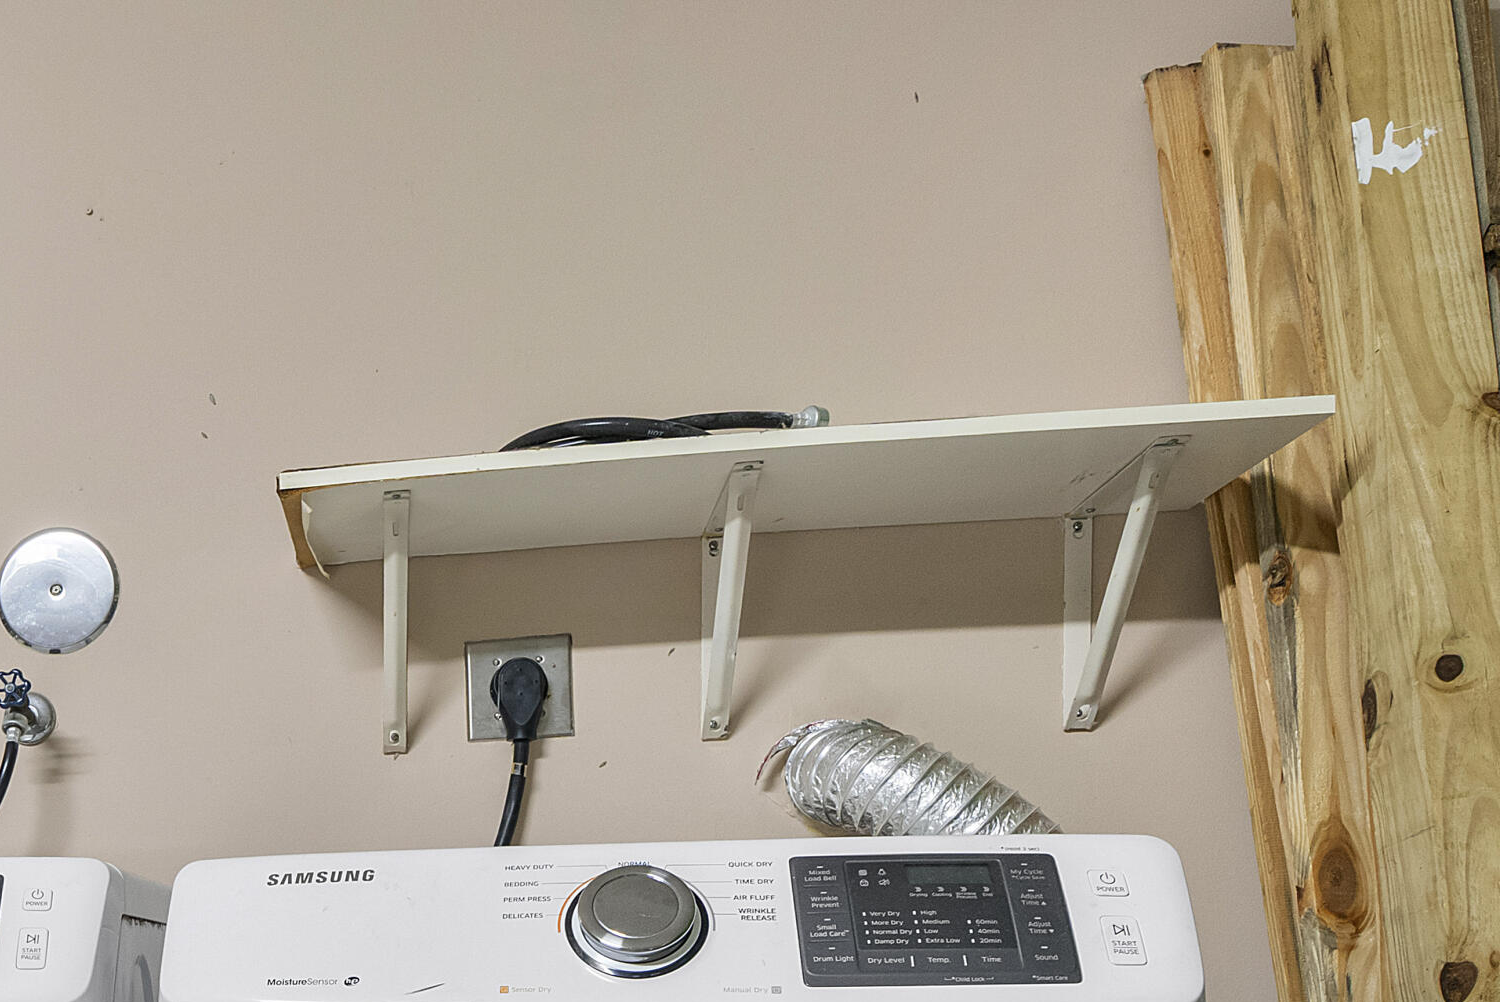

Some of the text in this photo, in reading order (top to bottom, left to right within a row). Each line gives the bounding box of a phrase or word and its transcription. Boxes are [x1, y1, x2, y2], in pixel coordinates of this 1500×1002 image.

[267, 869, 375, 886] SAMSUNG
[502, 912, 544, 920] DELICATES
[267, 977, 338, 986] MoistureSensor
[538, 986, 551, 994] Dry
[754, 987, 769, 995] Dry
